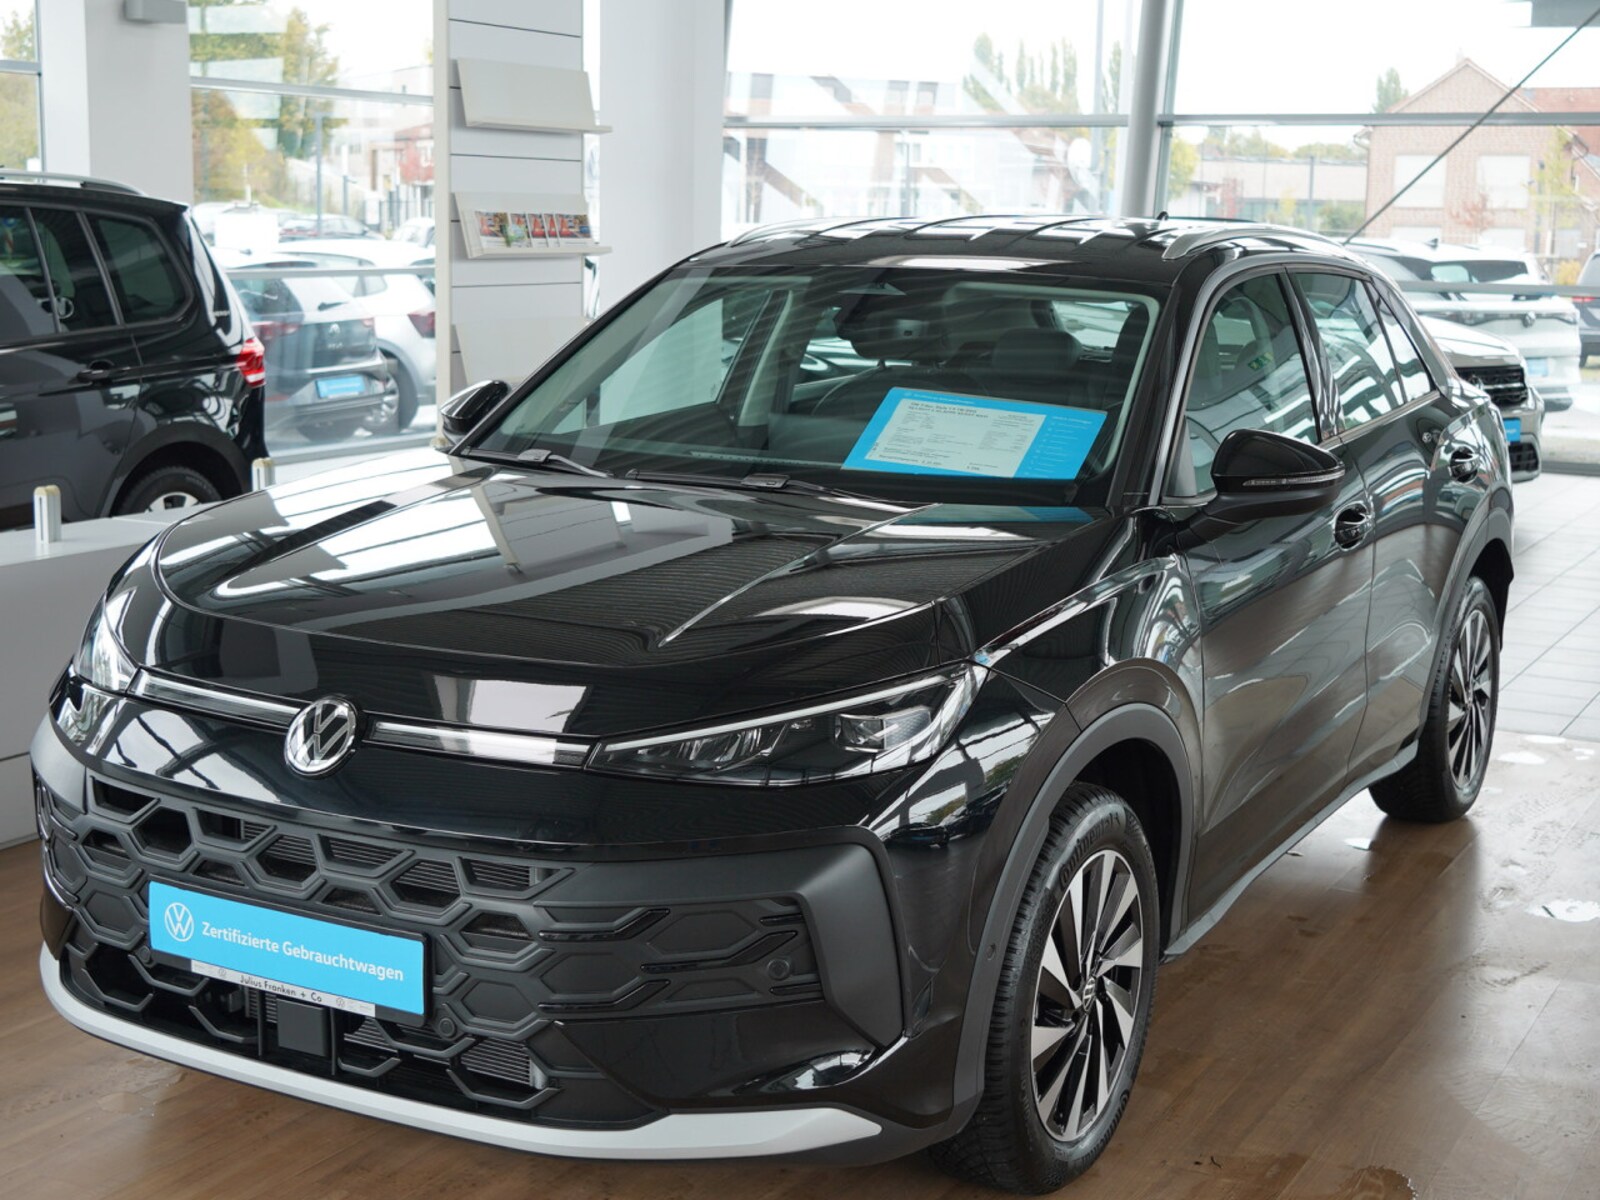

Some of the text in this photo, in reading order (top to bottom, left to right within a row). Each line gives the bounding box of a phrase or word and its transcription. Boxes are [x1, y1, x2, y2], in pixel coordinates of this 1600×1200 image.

[202, 921, 279, 953] Zertifizierte
[282, 941, 404, 981] Gebrauchtwagen
[240, 974, 262, 988] Julius
[264, 980, 297, 996] Franken
[310, 991, 322, 1003] Co
